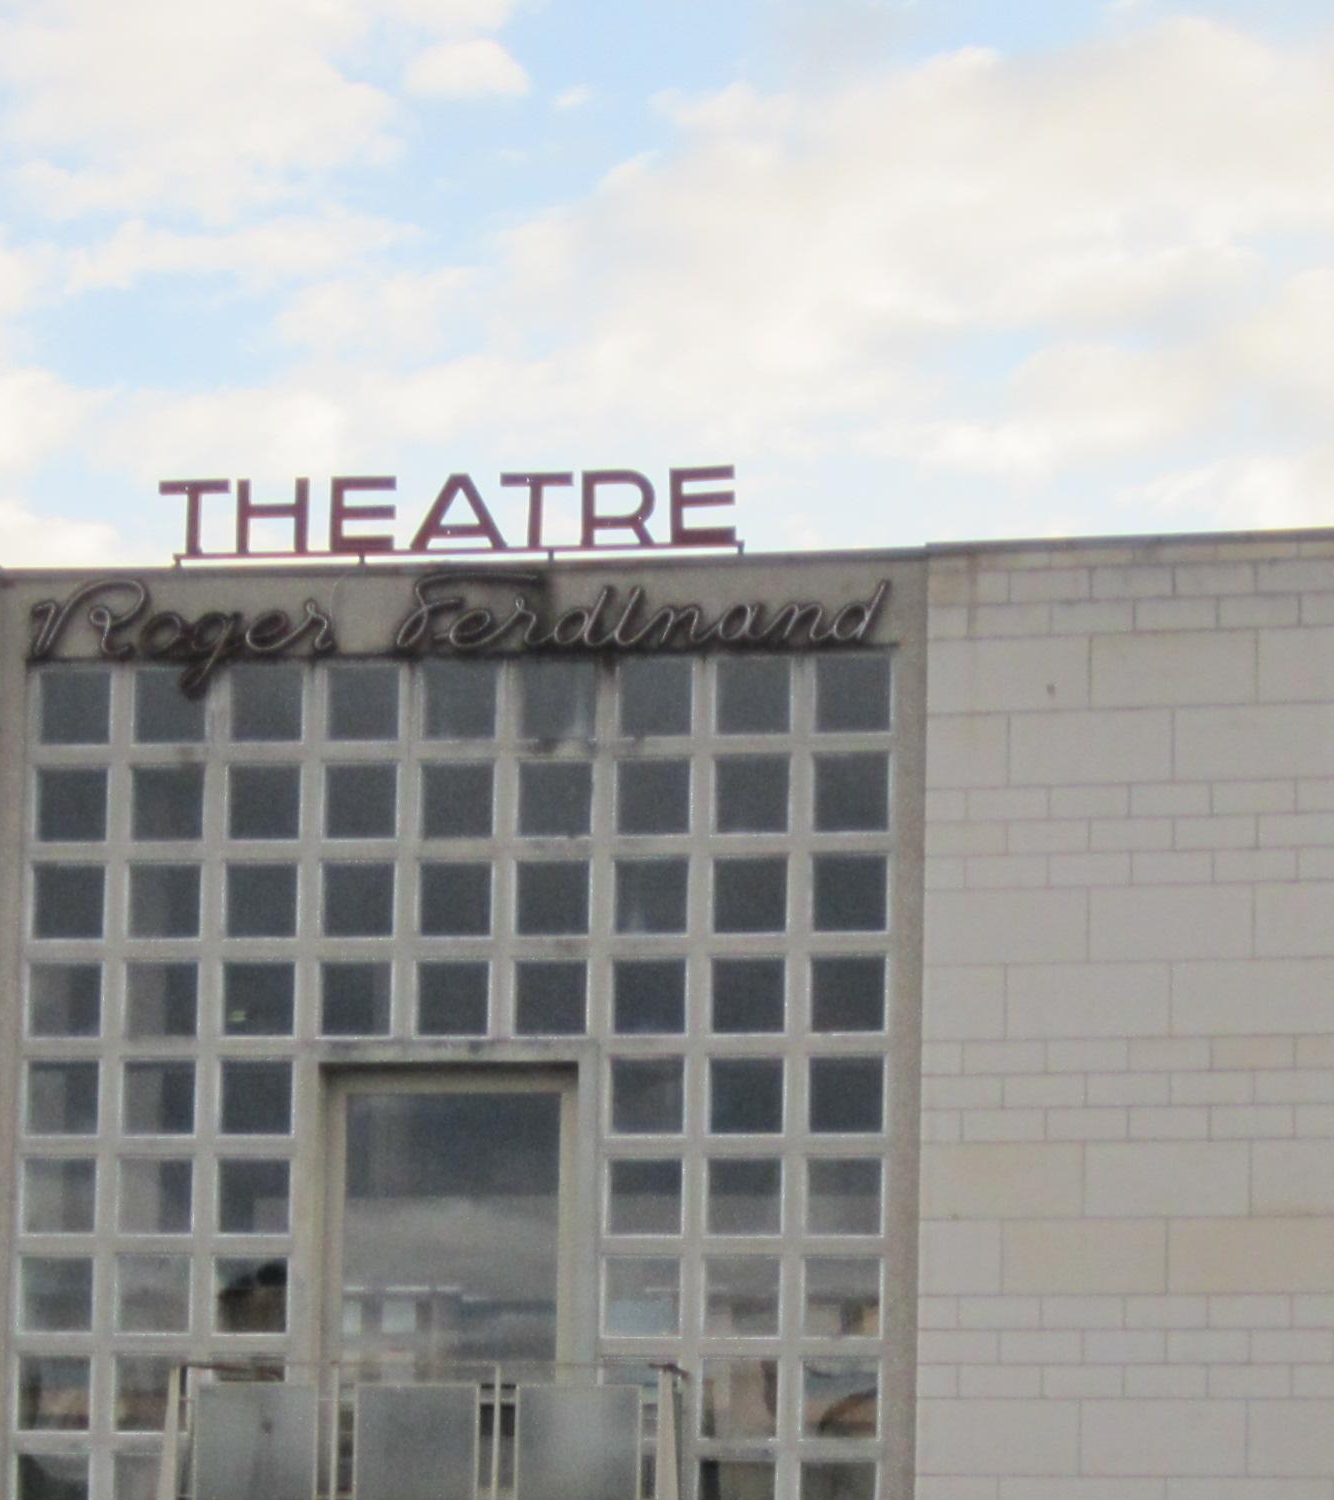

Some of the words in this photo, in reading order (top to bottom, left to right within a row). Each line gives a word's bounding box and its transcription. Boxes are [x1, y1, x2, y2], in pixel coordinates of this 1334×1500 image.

[159, 465, 735, 554] THEATRE
[30, 578, 336, 699] Roger
[395, 570, 891, 648] Ferdinand
